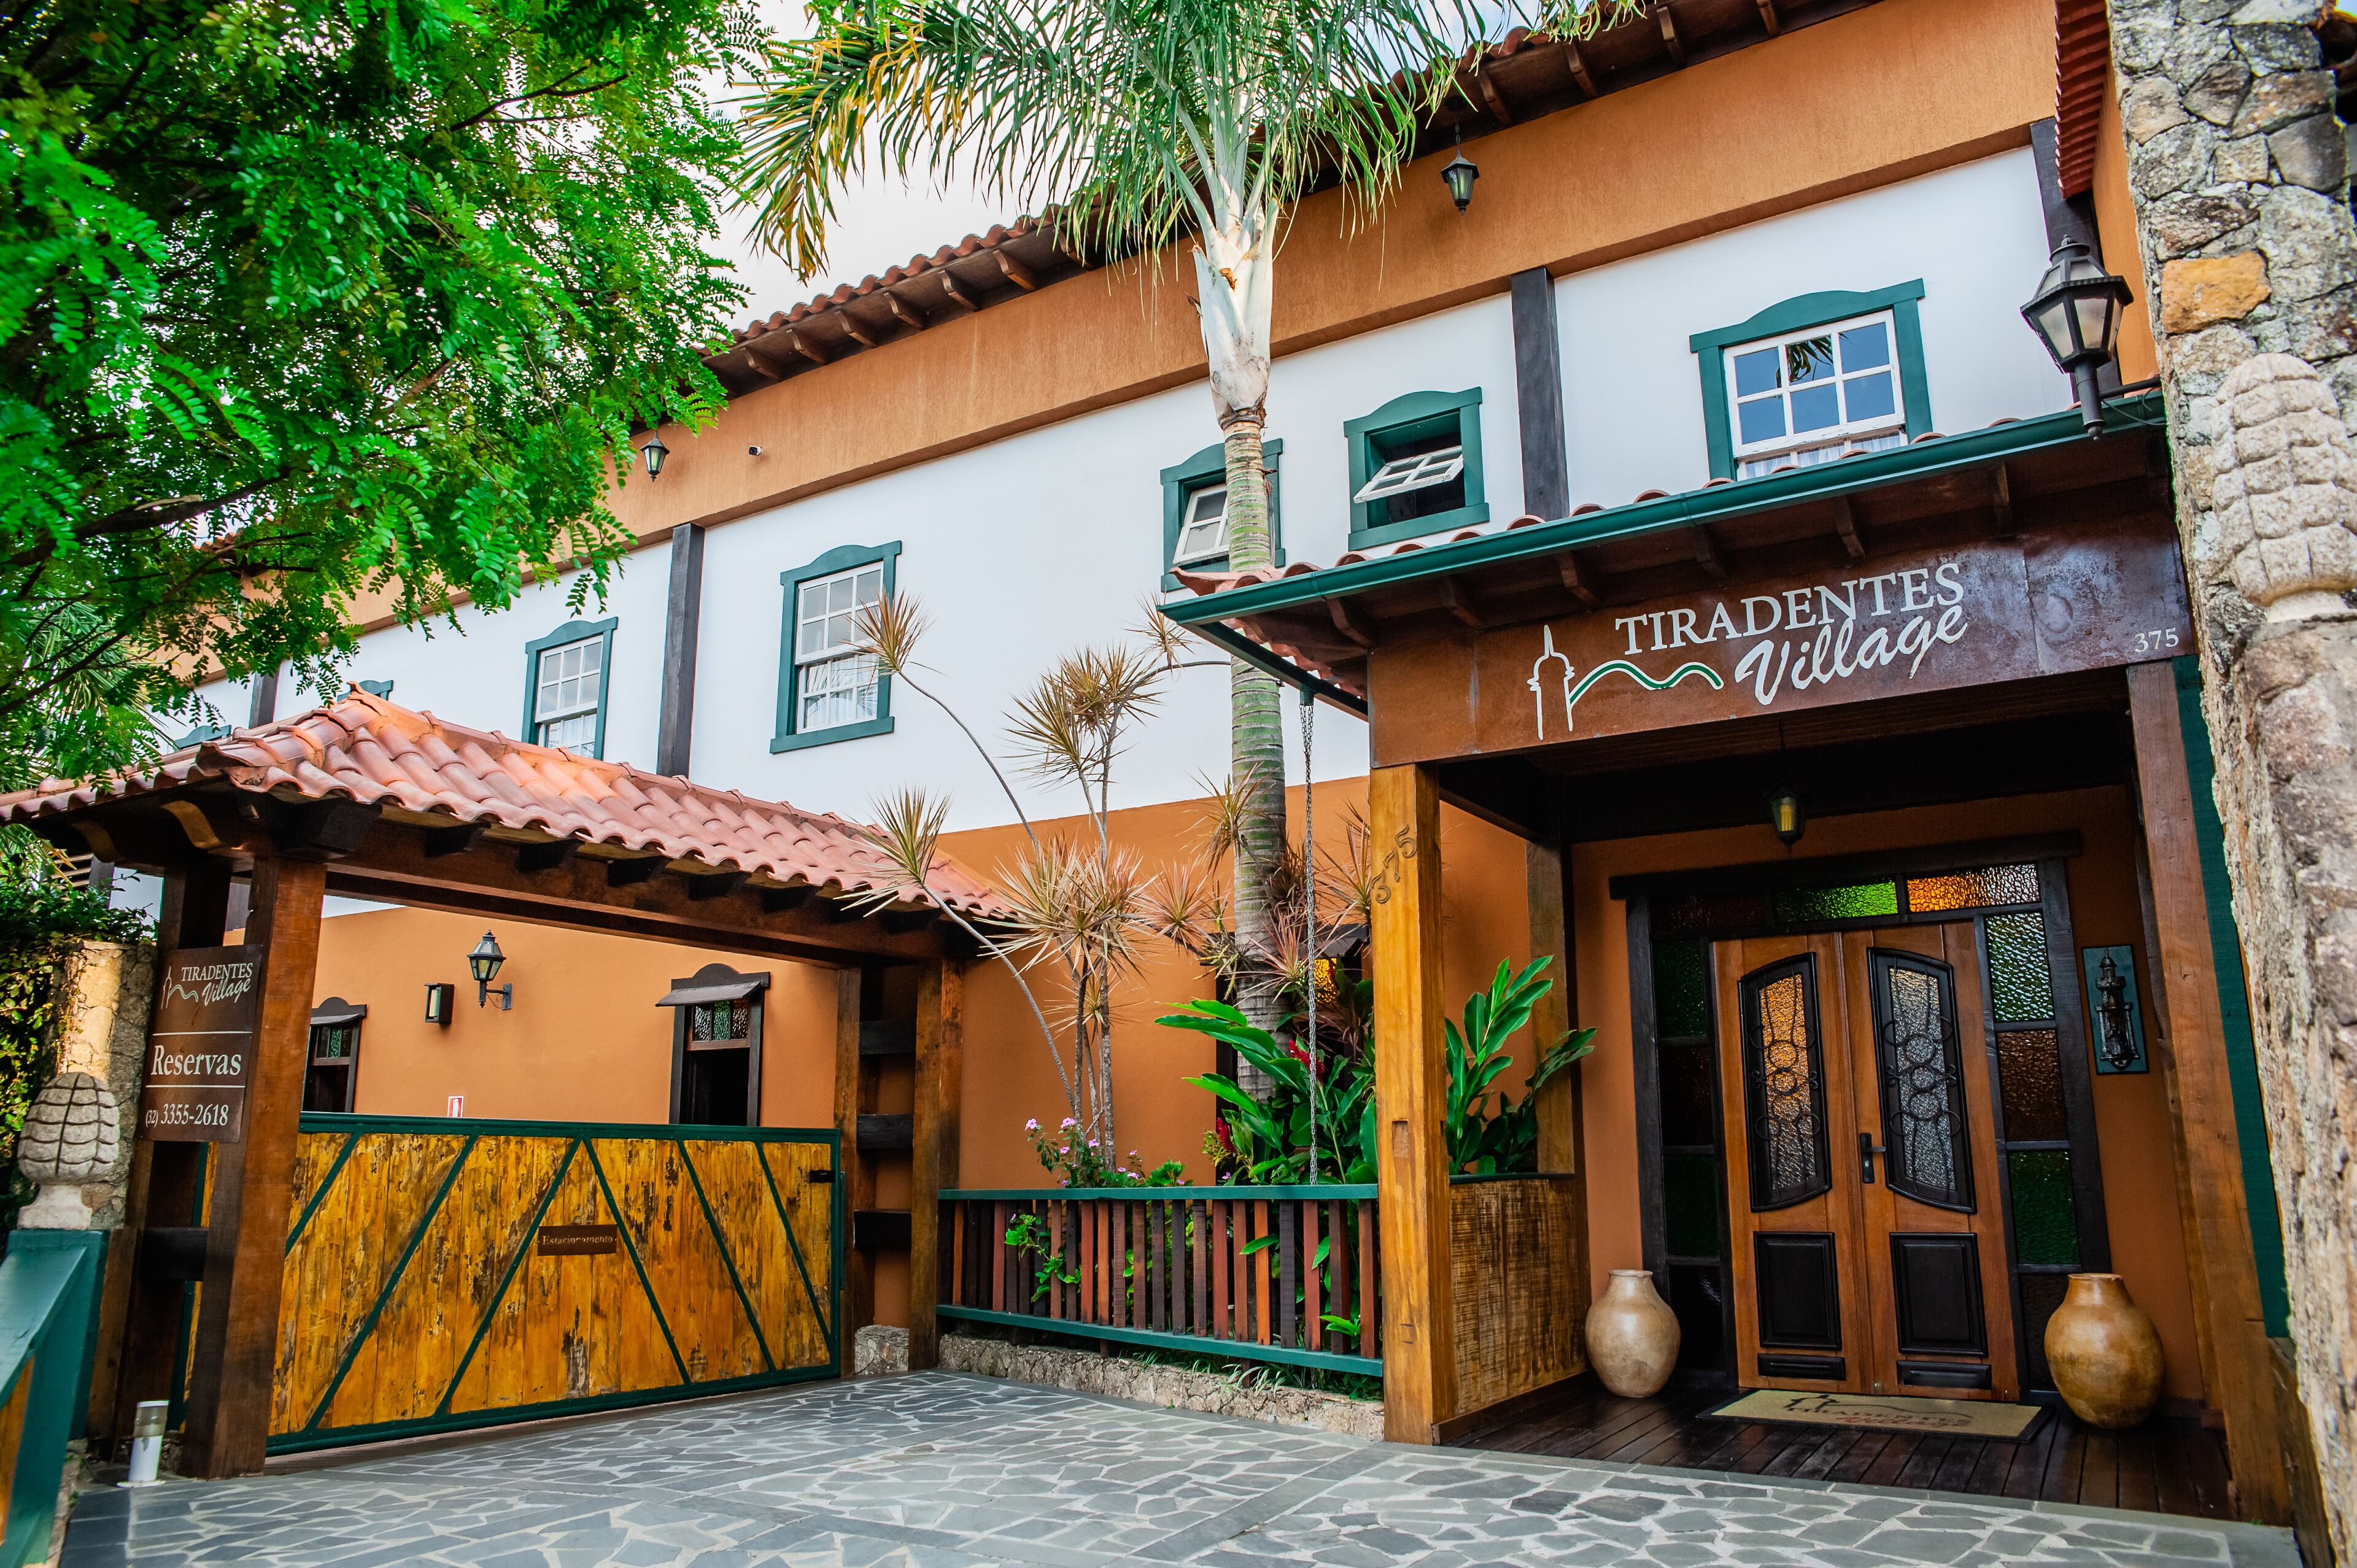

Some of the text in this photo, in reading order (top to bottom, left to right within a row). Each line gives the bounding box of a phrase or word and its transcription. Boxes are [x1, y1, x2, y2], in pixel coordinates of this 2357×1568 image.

[1615, 563, 1964, 655] TIRADENTES
[2134, 627, 2179, 652] 375
[1735, 605, 1968, 706] Village
[181, 962, 253, 982] TIRADENTES
[201, 978, 251, 1006] Village
[150, 1045, 242, 1075] Reservas
[145, 1103, 229, 1128] (32) 3355-2618
